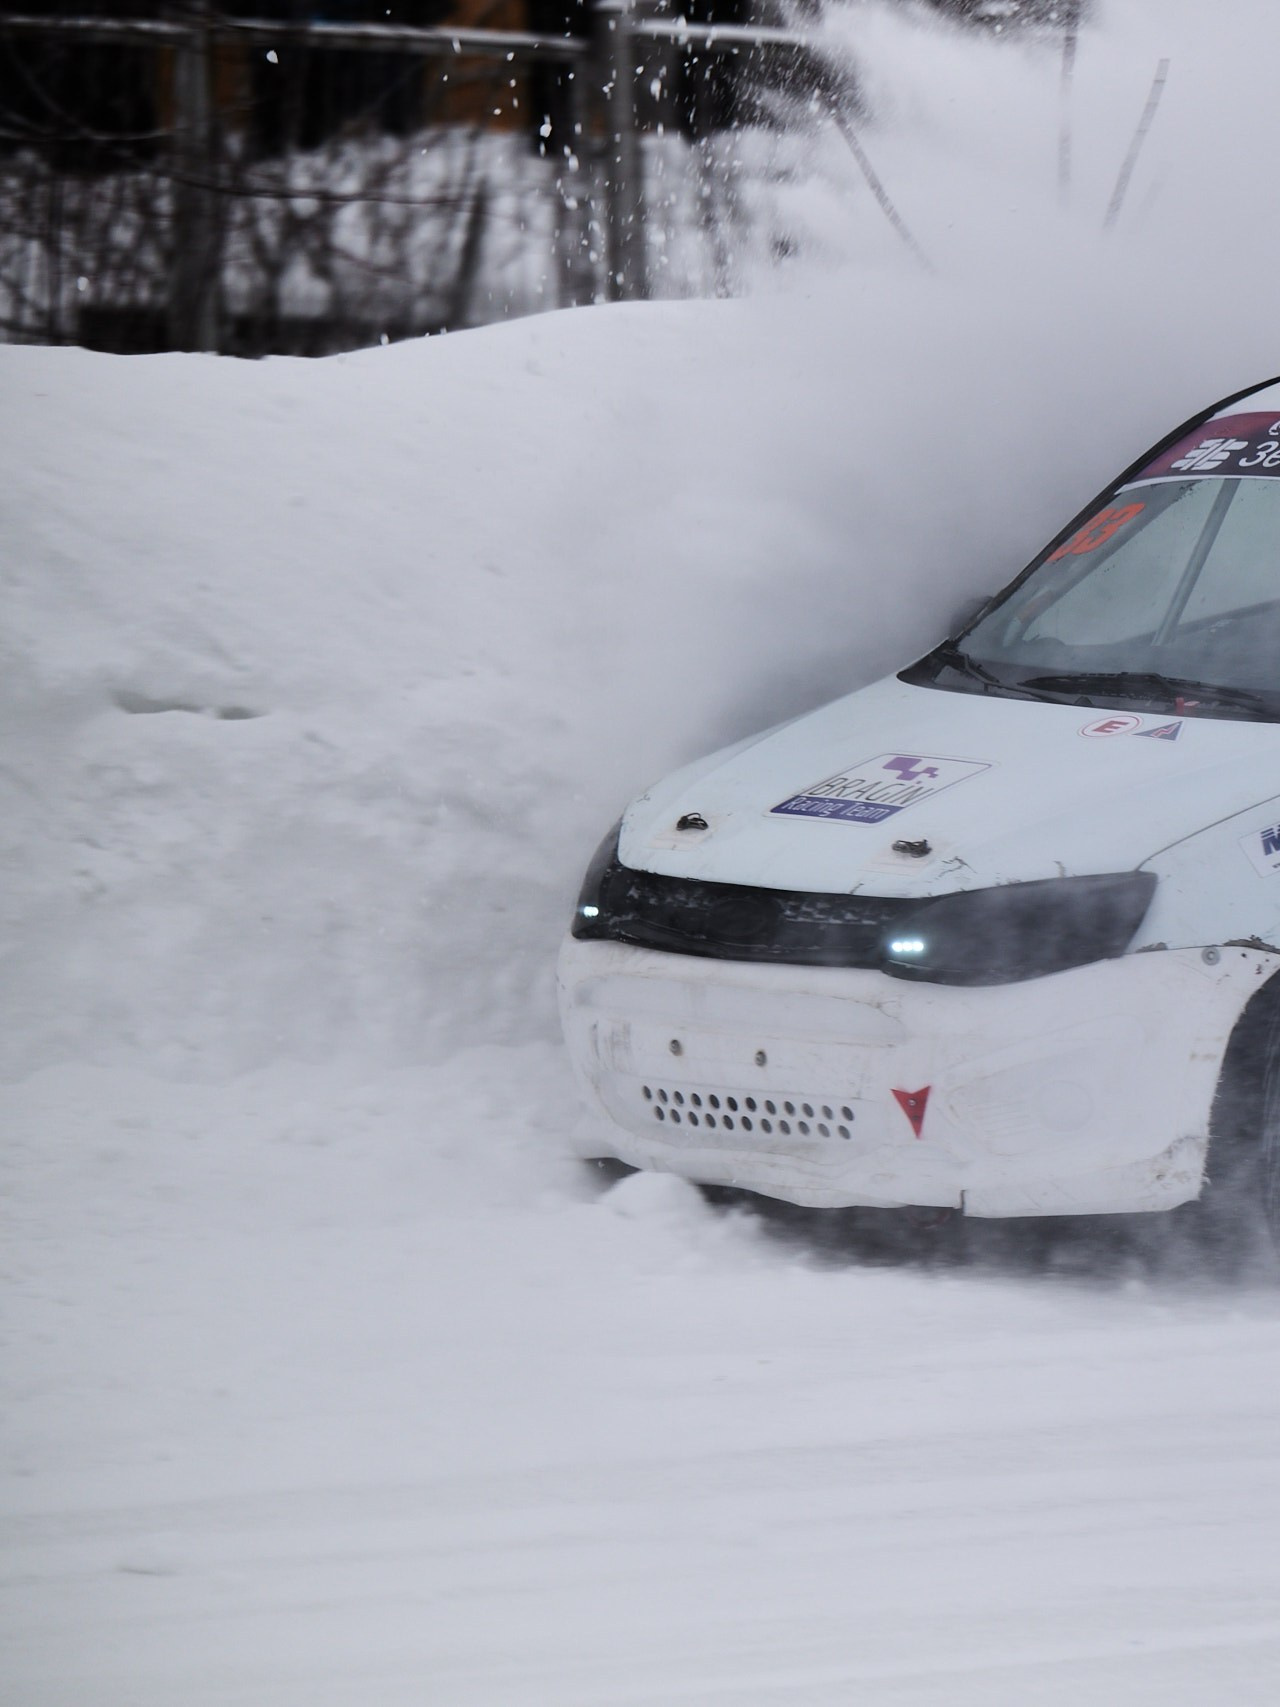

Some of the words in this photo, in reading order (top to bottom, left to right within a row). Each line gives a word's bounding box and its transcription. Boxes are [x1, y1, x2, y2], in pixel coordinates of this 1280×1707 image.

[1092, 720, 1130, 733] E
[782, 797, 846, 817] Racing
[840, 802, 890, 820] Team
